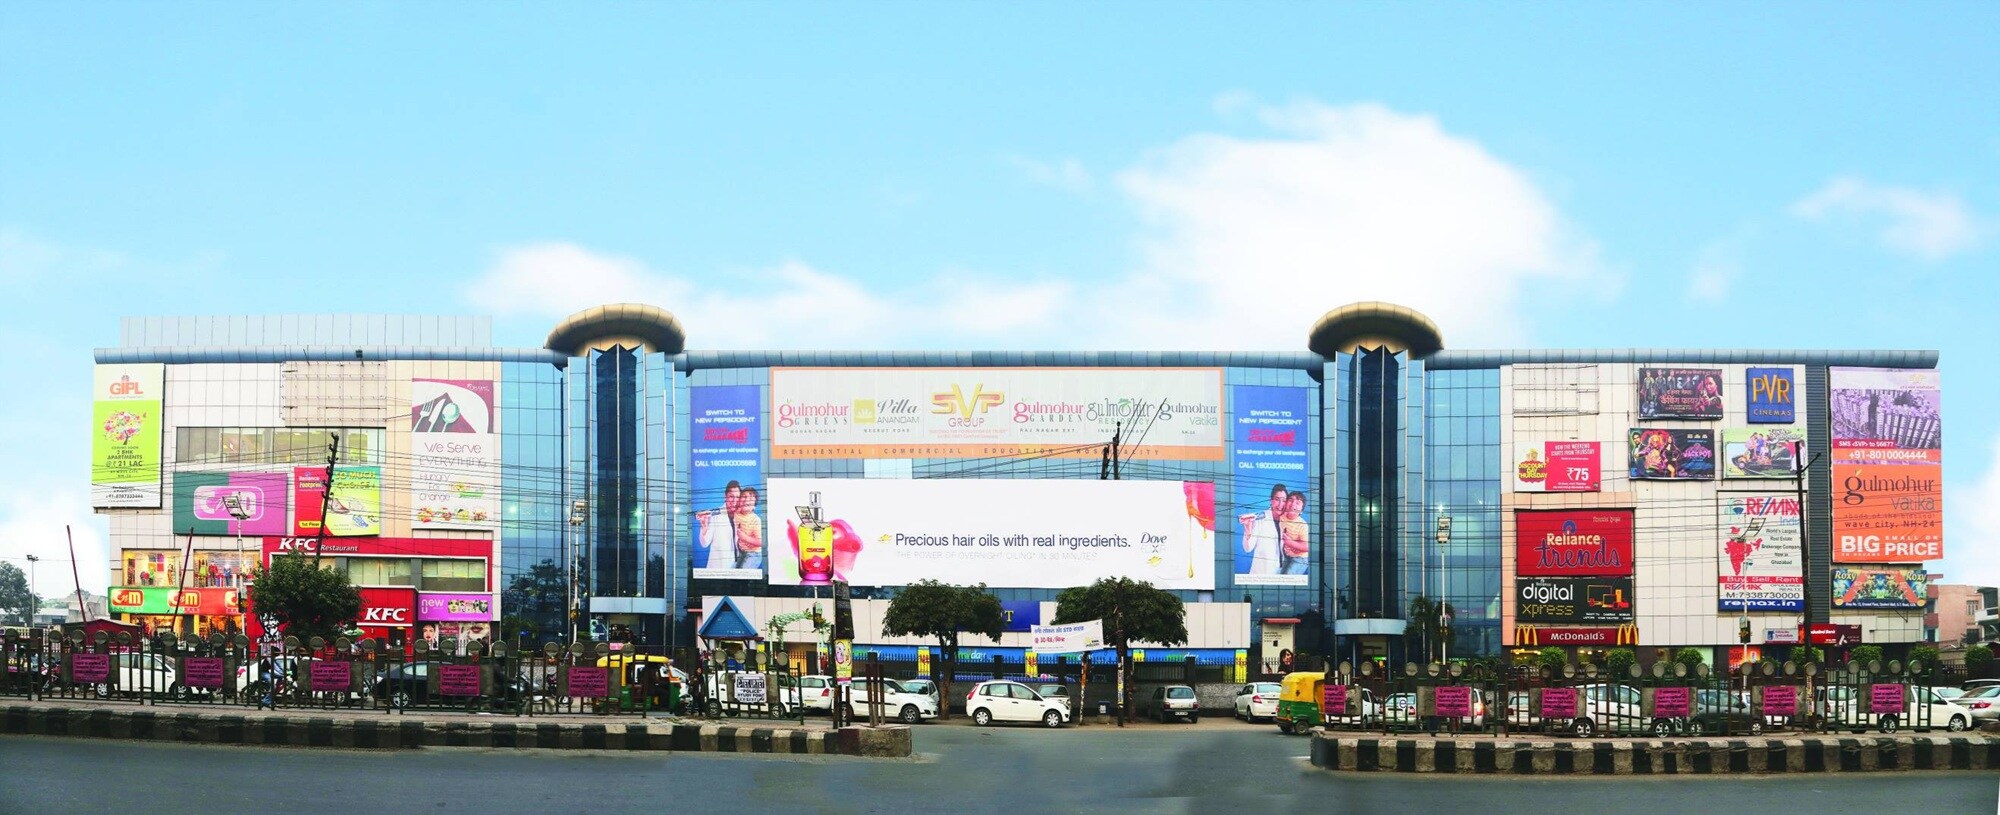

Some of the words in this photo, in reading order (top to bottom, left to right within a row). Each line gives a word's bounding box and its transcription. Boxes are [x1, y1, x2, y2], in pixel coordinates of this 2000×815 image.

[110, 382, 143, 395] GIPL
[1752, 374, 1790, 404] PVR
[877, 399, 918, 414] Villa
[931, 383, 1004, 422] SVP
[1086, 398, 1155, 421] gulmohur
[778, 402, 849, 428] gulmohur
[1013, 401, 1084, 423] gulmohur
[1030, 414, 1083, 423] GARDEN
[1158, 402, 1217, 421] gulmohur
[794, 417, 848, 425] GREENS
[948, 417, 985, 427] GROUP
[1189, 415, 1218, 426] vatika
[424, 442, 444, 453] We
[447, 442, 482, 453] Serve
[1683, 450, 1713, 459] JACKPOT
[1849, 450, 1927, 459] +91-8010004444
[419, 456, 487, 467] EVERYTHING
[1567, 467, 1589, 481] ₹75
[1843, 475, 1934, 505] gulmohur
[1891, 494, 1935, 511] vatika
[1903, 520, 1935, 528] NH-24
[278, 538, 317, 551] KFC
[320, 544, 358, 552] Restaurant
[895, 533, 949, 546] Precious
[952, 534, 975, 546] hair
[978, 534, 1000, 546] oils
[1003, 534, 1029, 546] with
[1033, 534, 1055, 547] real
[1059, 534, 1131, 550] ingredients.
[1140, 532, 1167, 544] Dove
[1547, 532, 1601, 546] Reliance
[1841, 535, 1880, 553] BIG
[897, 551, 911, 559] THE
[914, 551, 942, 559] POWER
[945, 551, 957, 559] OF
[960, 551, 1003, 560] OVERNIGHT
[1062, 552, 1098, 560] MINUTES
[1533, 537, 1622, 569] trends
[1885, 542, 1939, 556] PRICE
[1834, 570, 1857, 582] Roxy
[1906, 570, 1927, 582] Roxy
[1522, 583, 1573, 604] digital
[365, 607, 406, 621] KFC
[1522, 604, 1574, 618] xpress
[1551, 631, 1605, 640] McDonald's
